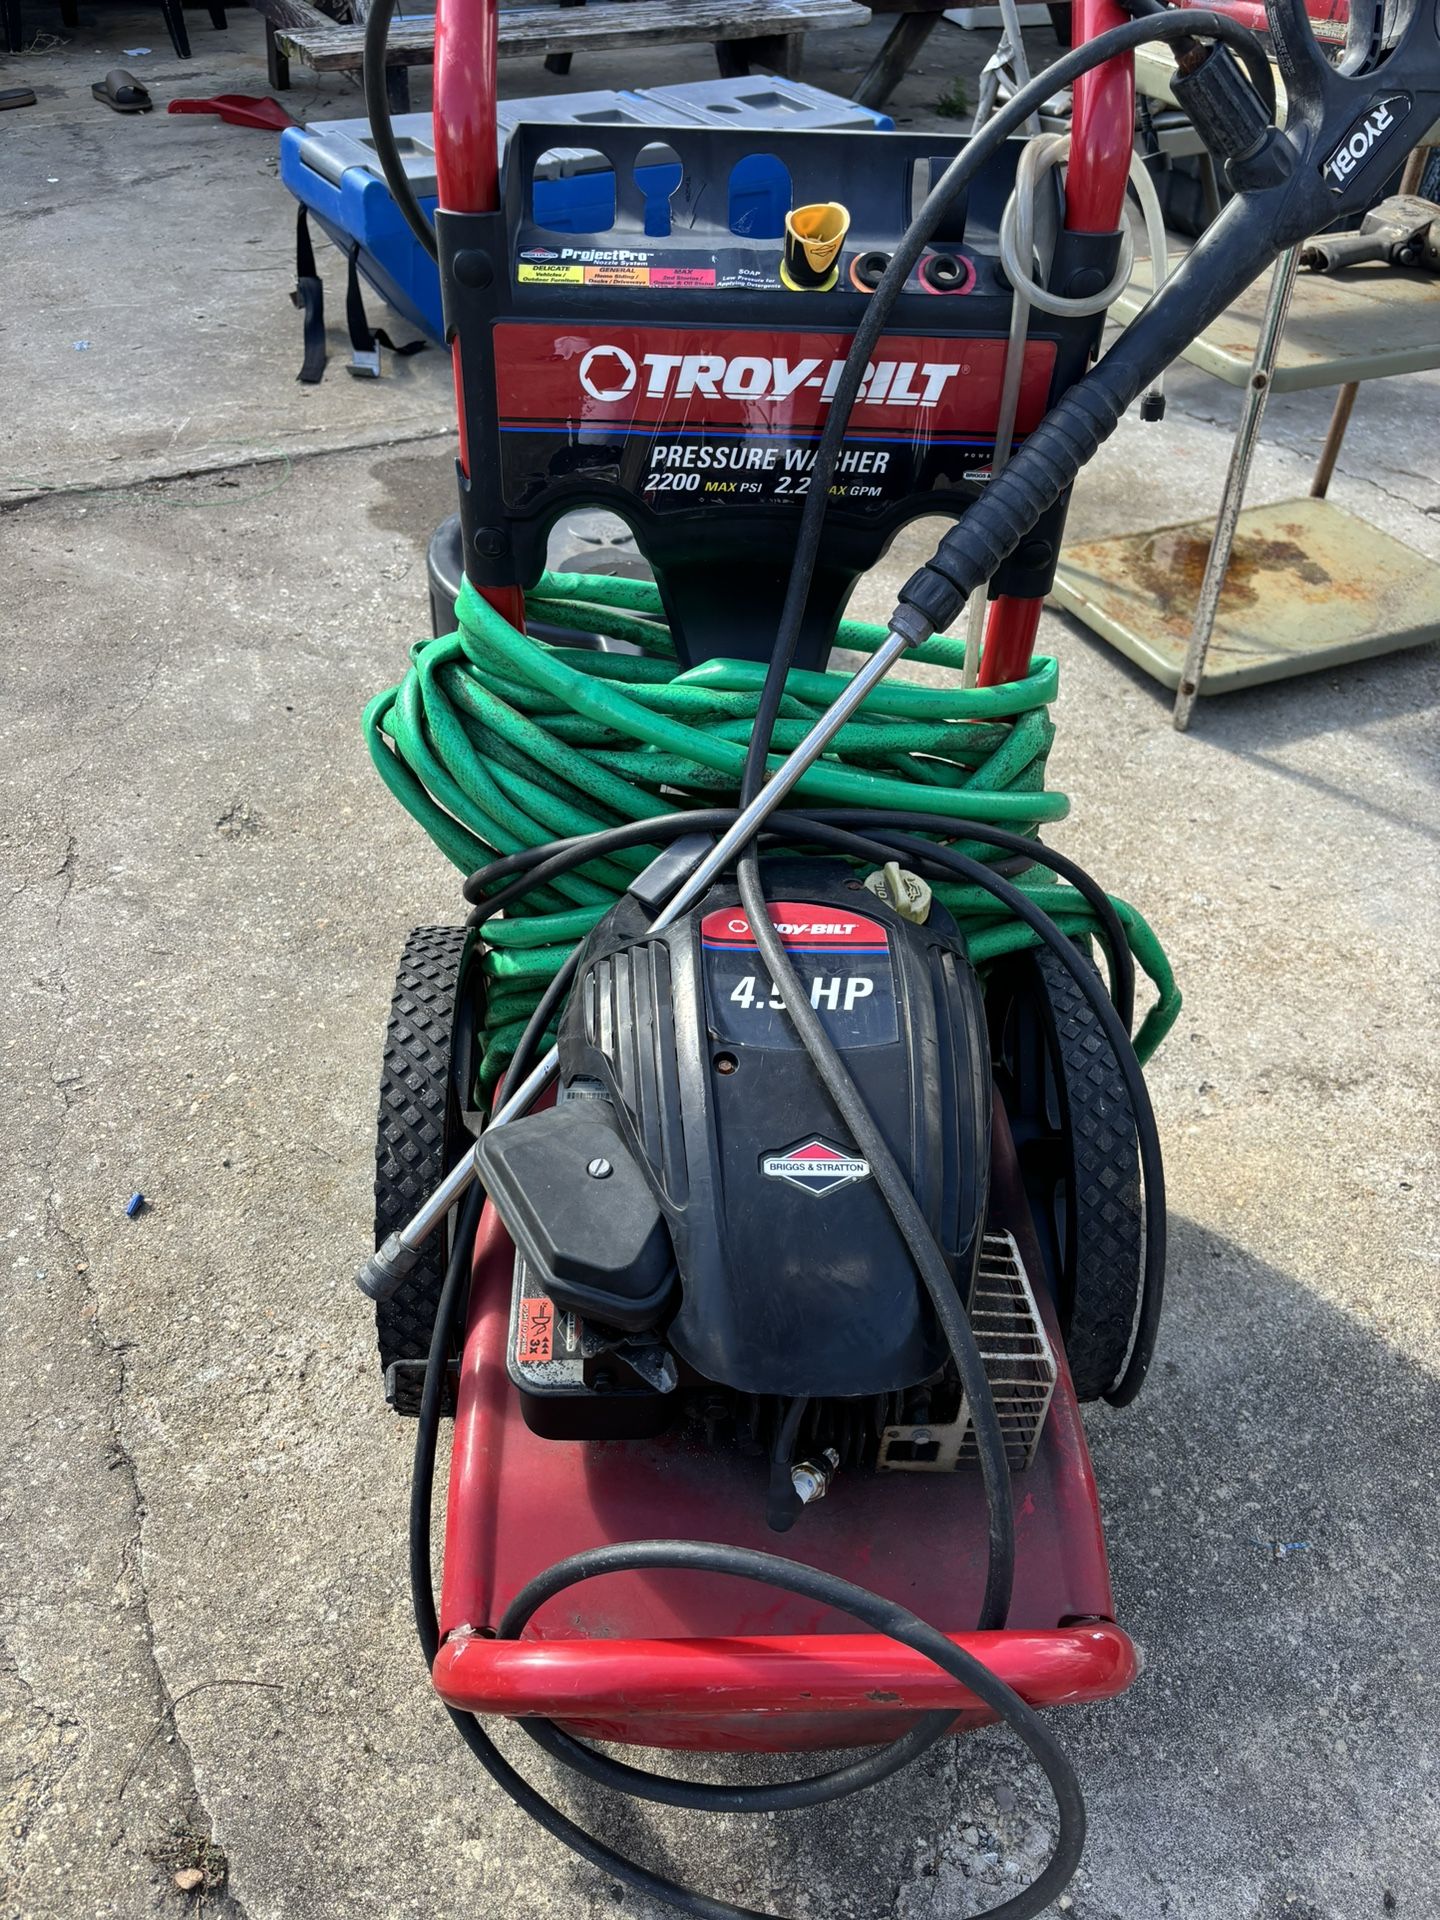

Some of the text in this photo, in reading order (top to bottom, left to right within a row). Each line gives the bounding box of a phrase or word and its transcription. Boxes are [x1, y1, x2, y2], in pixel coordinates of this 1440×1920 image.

[1330, 104, 1394, 182] RYOBI
[651, 445, 778, 472] PRESSURE
[644, 473, 883, 497] 2200 MAX PSI 2.2 AX GPM
[874, 880, 888, 900] OIL
[774, 923, 856, 935] OY-BILT
[811, 977, 874, 1011] HP
[769, 1163, 864, 1172] BRIGGS & STRATTON
